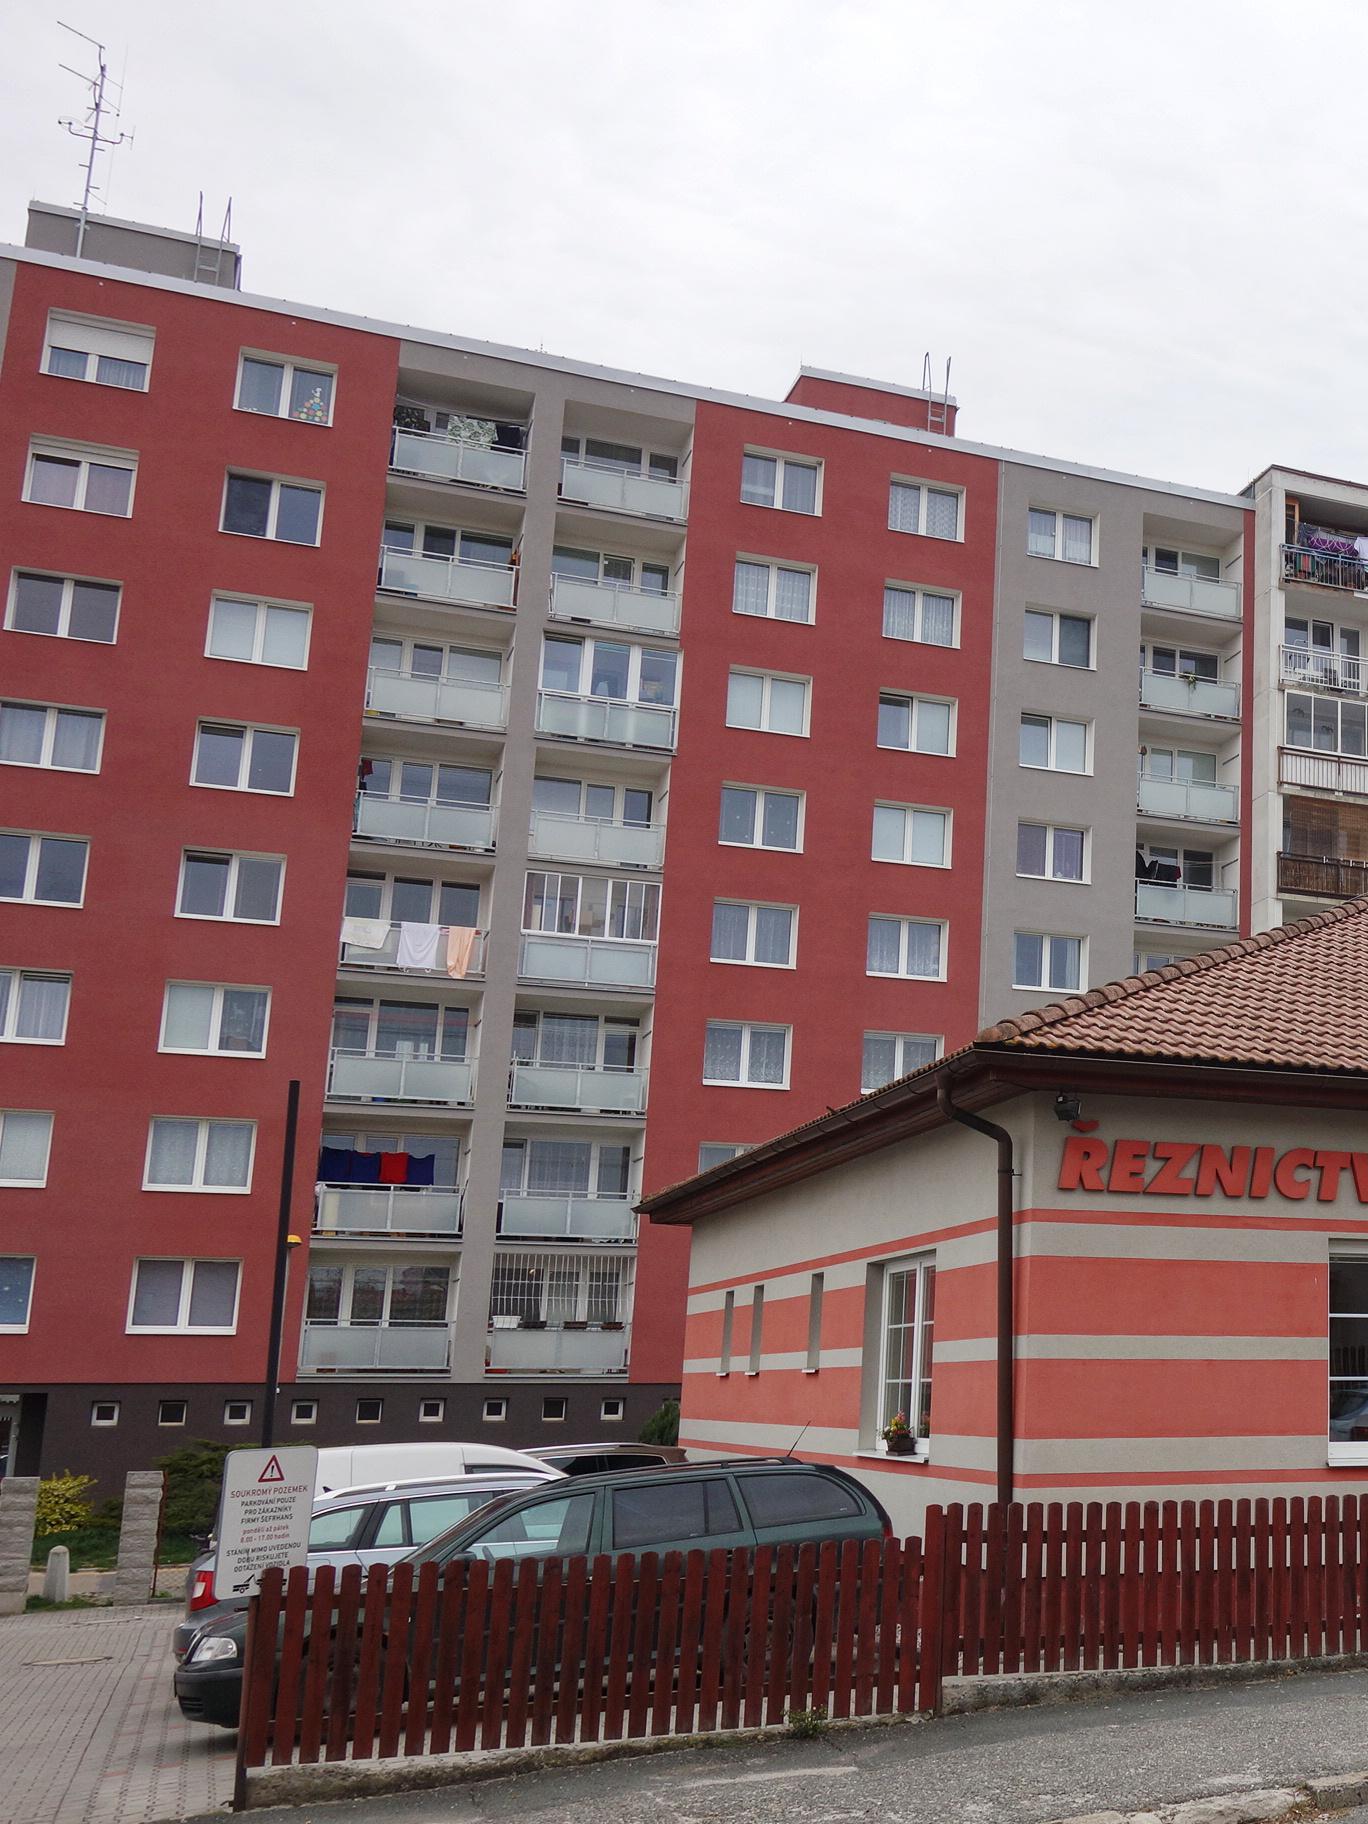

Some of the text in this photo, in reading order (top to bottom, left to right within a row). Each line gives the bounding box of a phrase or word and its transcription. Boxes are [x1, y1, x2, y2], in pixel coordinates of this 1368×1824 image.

[273, 1485, 308, 1495] POZEMEK
[276, 1496, 296, 1504] POUZE
[260, 1513, 294, 1523] ŠEFRHANS
[251, 1545, 268, 1554] MIMO
[269, 1542, 301, 1551] UVEDENOU
[255, 1552, 288, 1561] RISKUJETE
